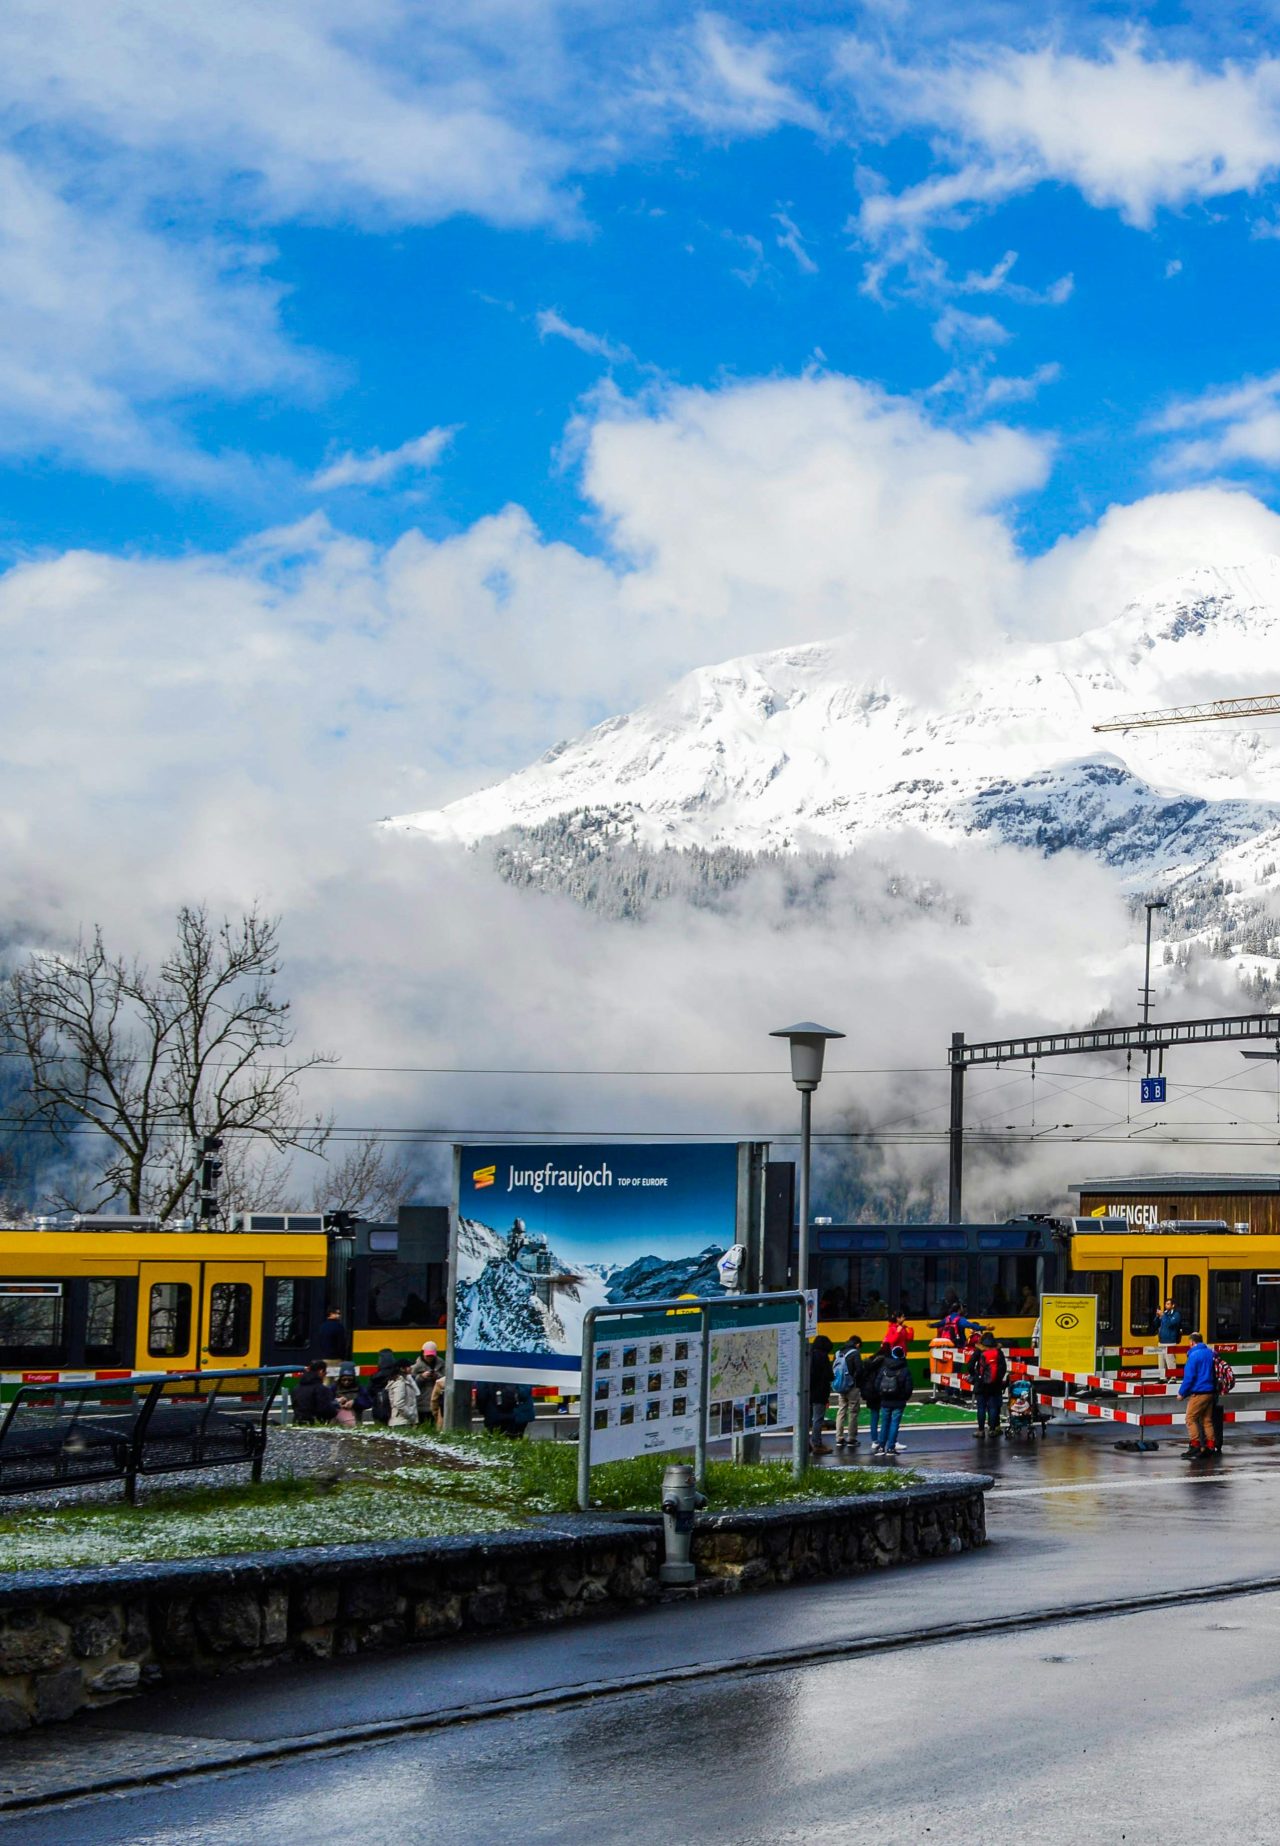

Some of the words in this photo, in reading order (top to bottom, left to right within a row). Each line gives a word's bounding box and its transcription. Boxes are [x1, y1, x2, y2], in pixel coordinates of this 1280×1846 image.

[1143, 1086, 1149, 1099] 3
[1155, 1085, 1161, 1098] B
[507, 1163, 613, 1193] Jungfraujoch
[617, 1177, 631, 1186] TOP
[632, 1178, 641, 1186] OF
[642, 1178, 668, 1187] EUROPE
[1108, 1204, 1158, 1225] WENGEN
